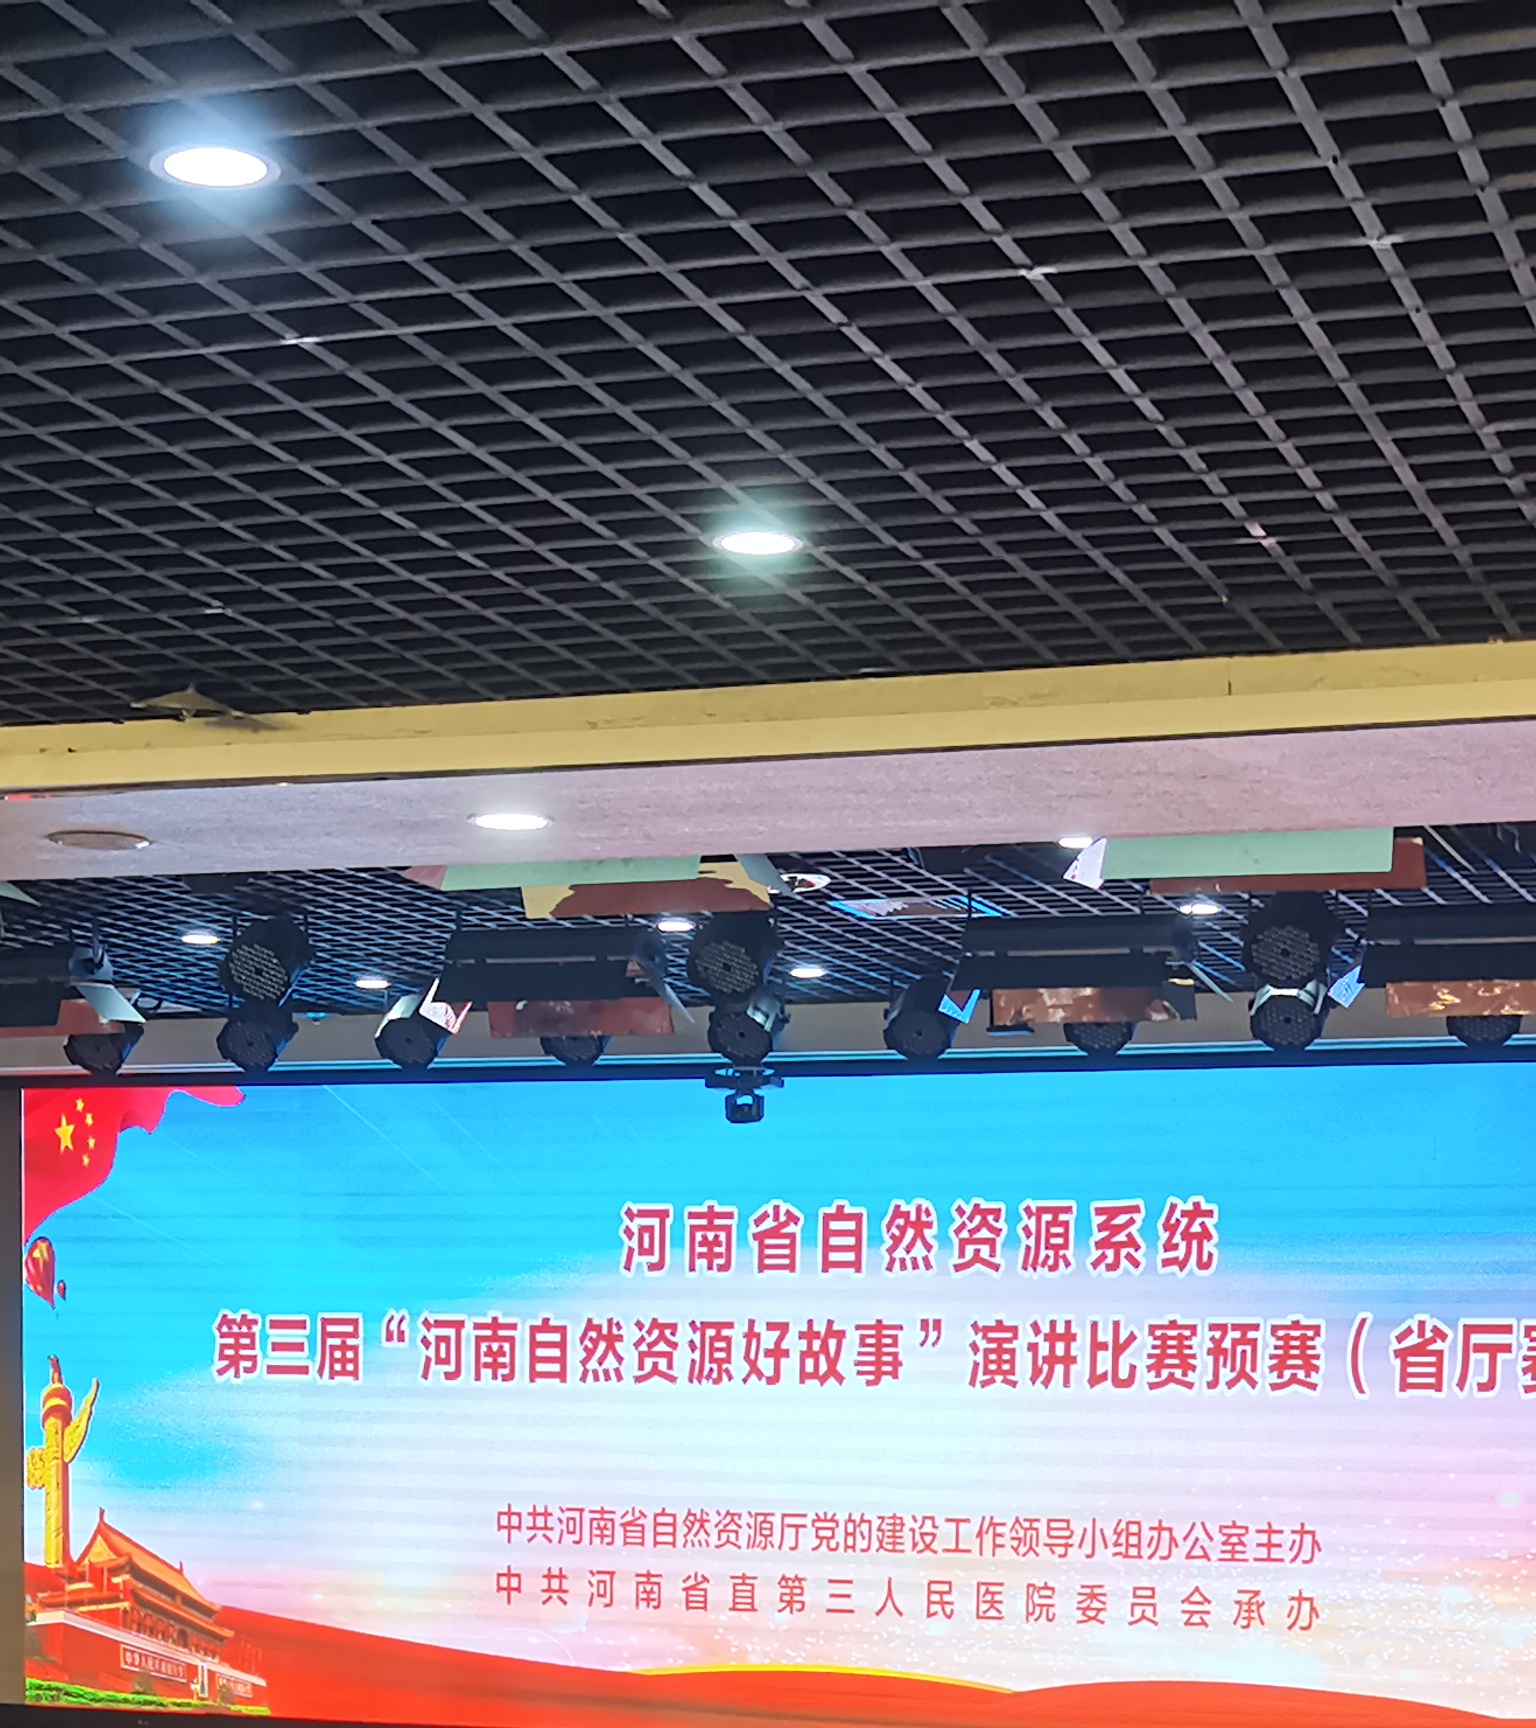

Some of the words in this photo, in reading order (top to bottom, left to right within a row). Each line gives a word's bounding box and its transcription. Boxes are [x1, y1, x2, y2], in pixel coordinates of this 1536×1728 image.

[620, 1199, 1220, 1275] 河南省自然资源系统
[495, 1503, 1323, 1565] 中共河南省自然资源厅党的建设工作领导小组办公室主办
[495, 1564, 1321, 1632] 中共河南省直第三人民医院委员会承办
